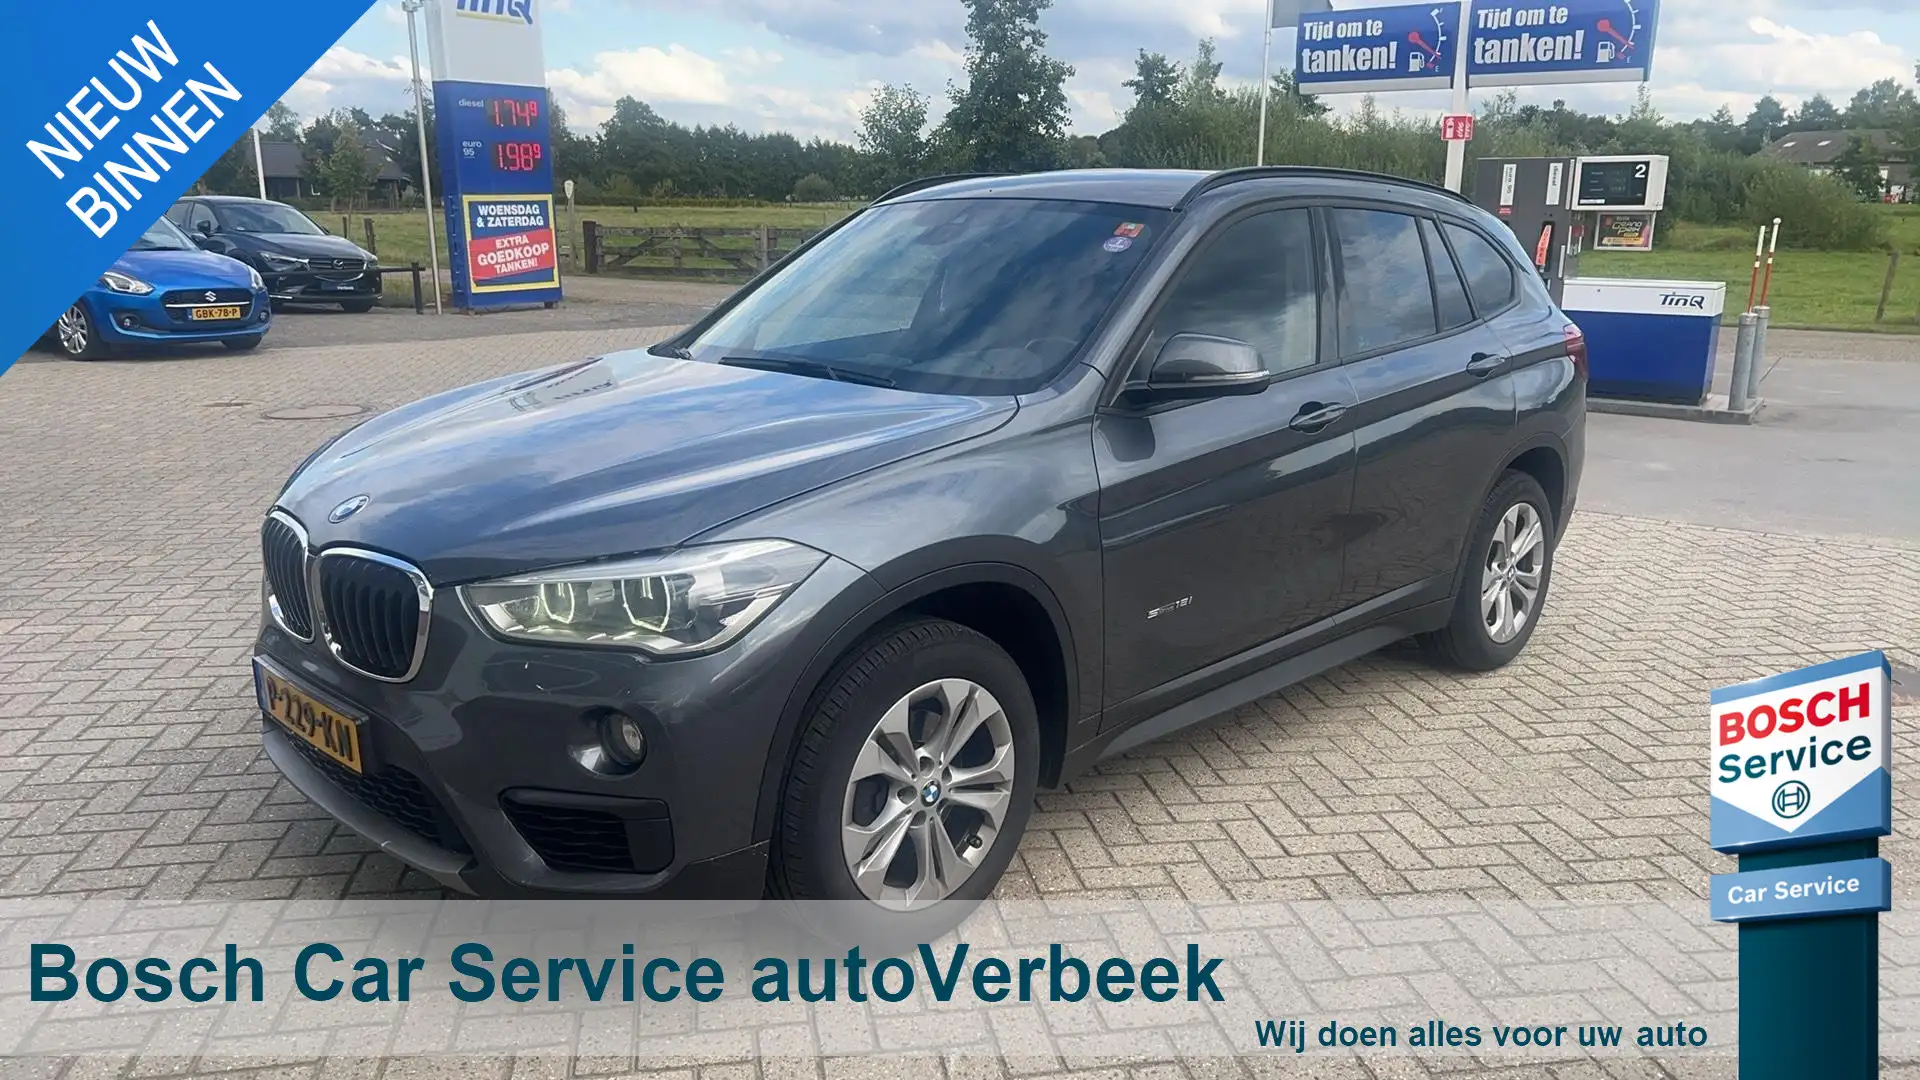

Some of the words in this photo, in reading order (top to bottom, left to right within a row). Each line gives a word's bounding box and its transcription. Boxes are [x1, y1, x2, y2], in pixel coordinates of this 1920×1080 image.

[1477, 7, 1512, 30] Tijd
[1515, 11, 1545, 27] om
[1549, 6, 1569, 25] te
[1303, 20, 1334, 42] Tijd
[1336, 23, 1362, 39] om
[1366, 19, 1383, 37] te
[1474, 29, 1585, 65] tanken!
[1301, 41, 1398, 74] tanken!
[458, 98, 485, 108] diesel
[462, 140, 483, 148] euro
[1634, 163, 1647, 178] 2
[478, 204, 540, 216] WOENSDAG
[476, 217, 485, 228] &
[487, 215, 544, 228] ZATERDAG
[495, 234, 530, 249] EXTRA
[477, 242, 550, 266] GOEDKOOP
[494, 257, 538, 274] TANKEN!
[1659, 291, 1705, 310] TinQ
[266, 675, 354, 762] P-229-KN
